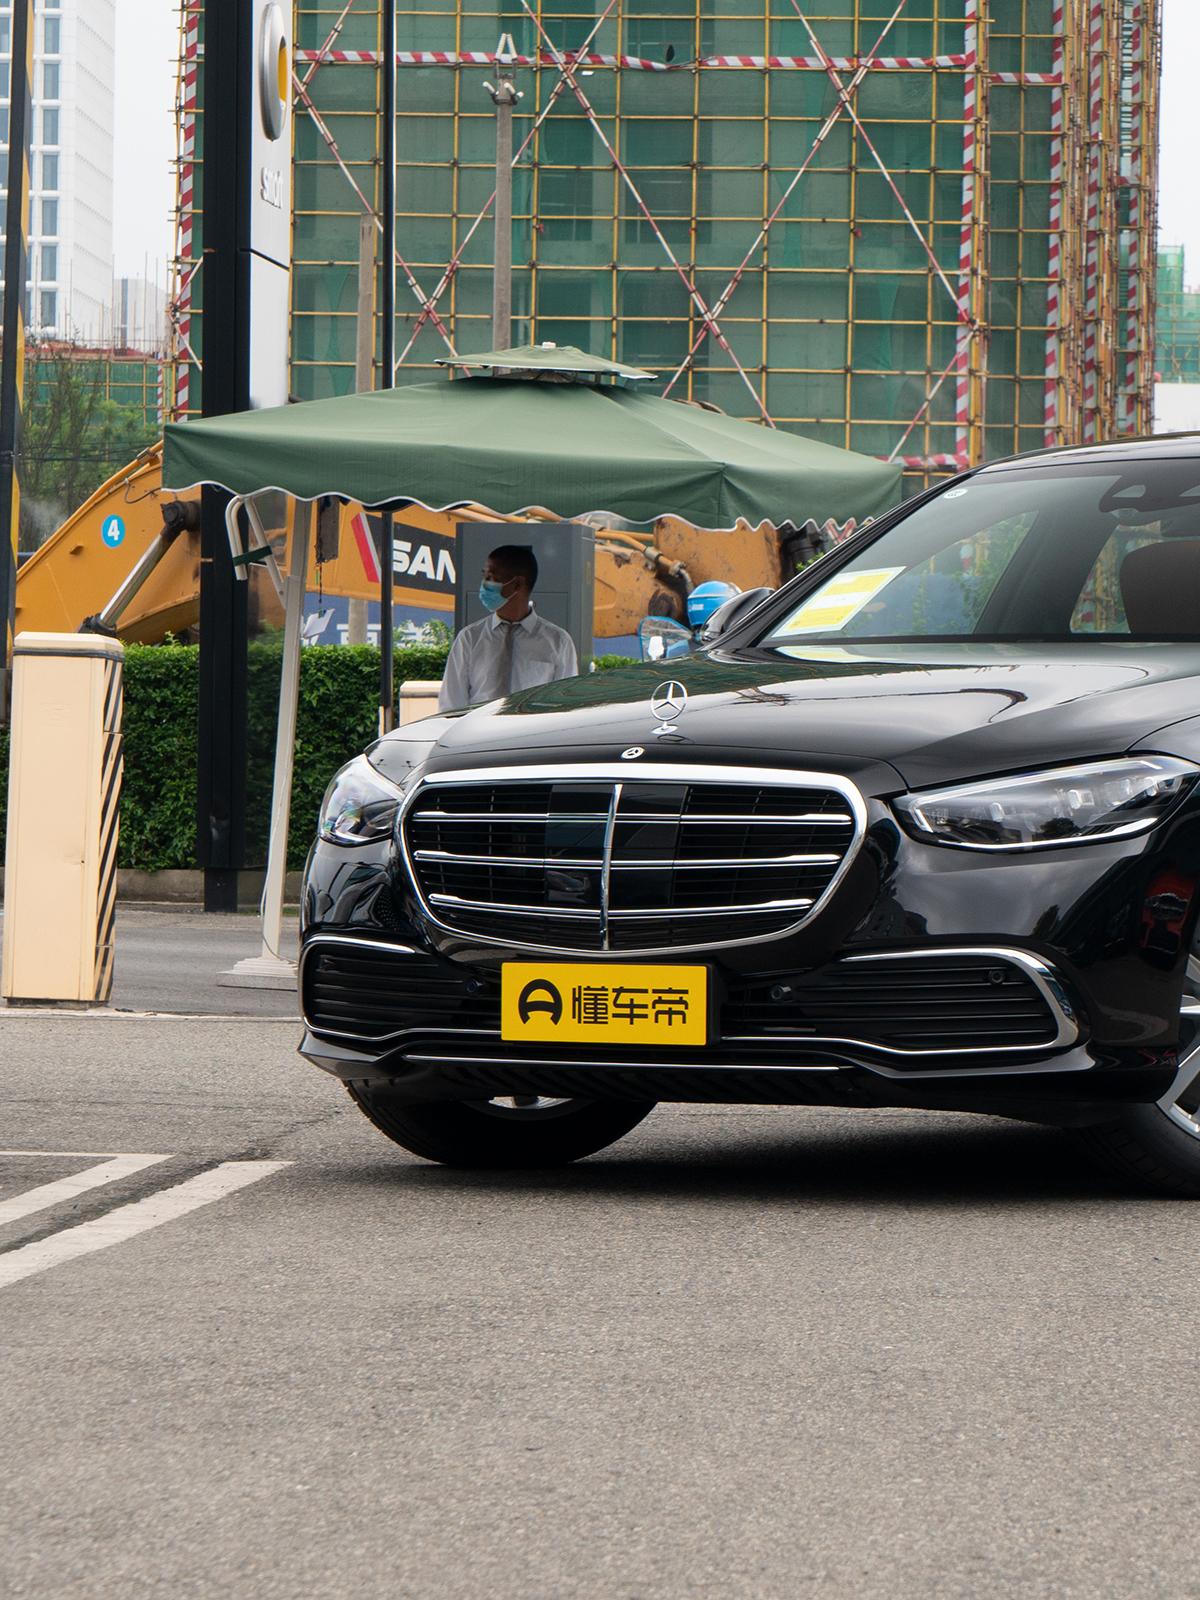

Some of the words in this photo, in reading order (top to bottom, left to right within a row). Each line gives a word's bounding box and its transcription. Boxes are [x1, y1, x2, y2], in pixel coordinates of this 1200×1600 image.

[107, 519, 120, 541] 4
[572, 985, 689, 1026] 懂车帝
